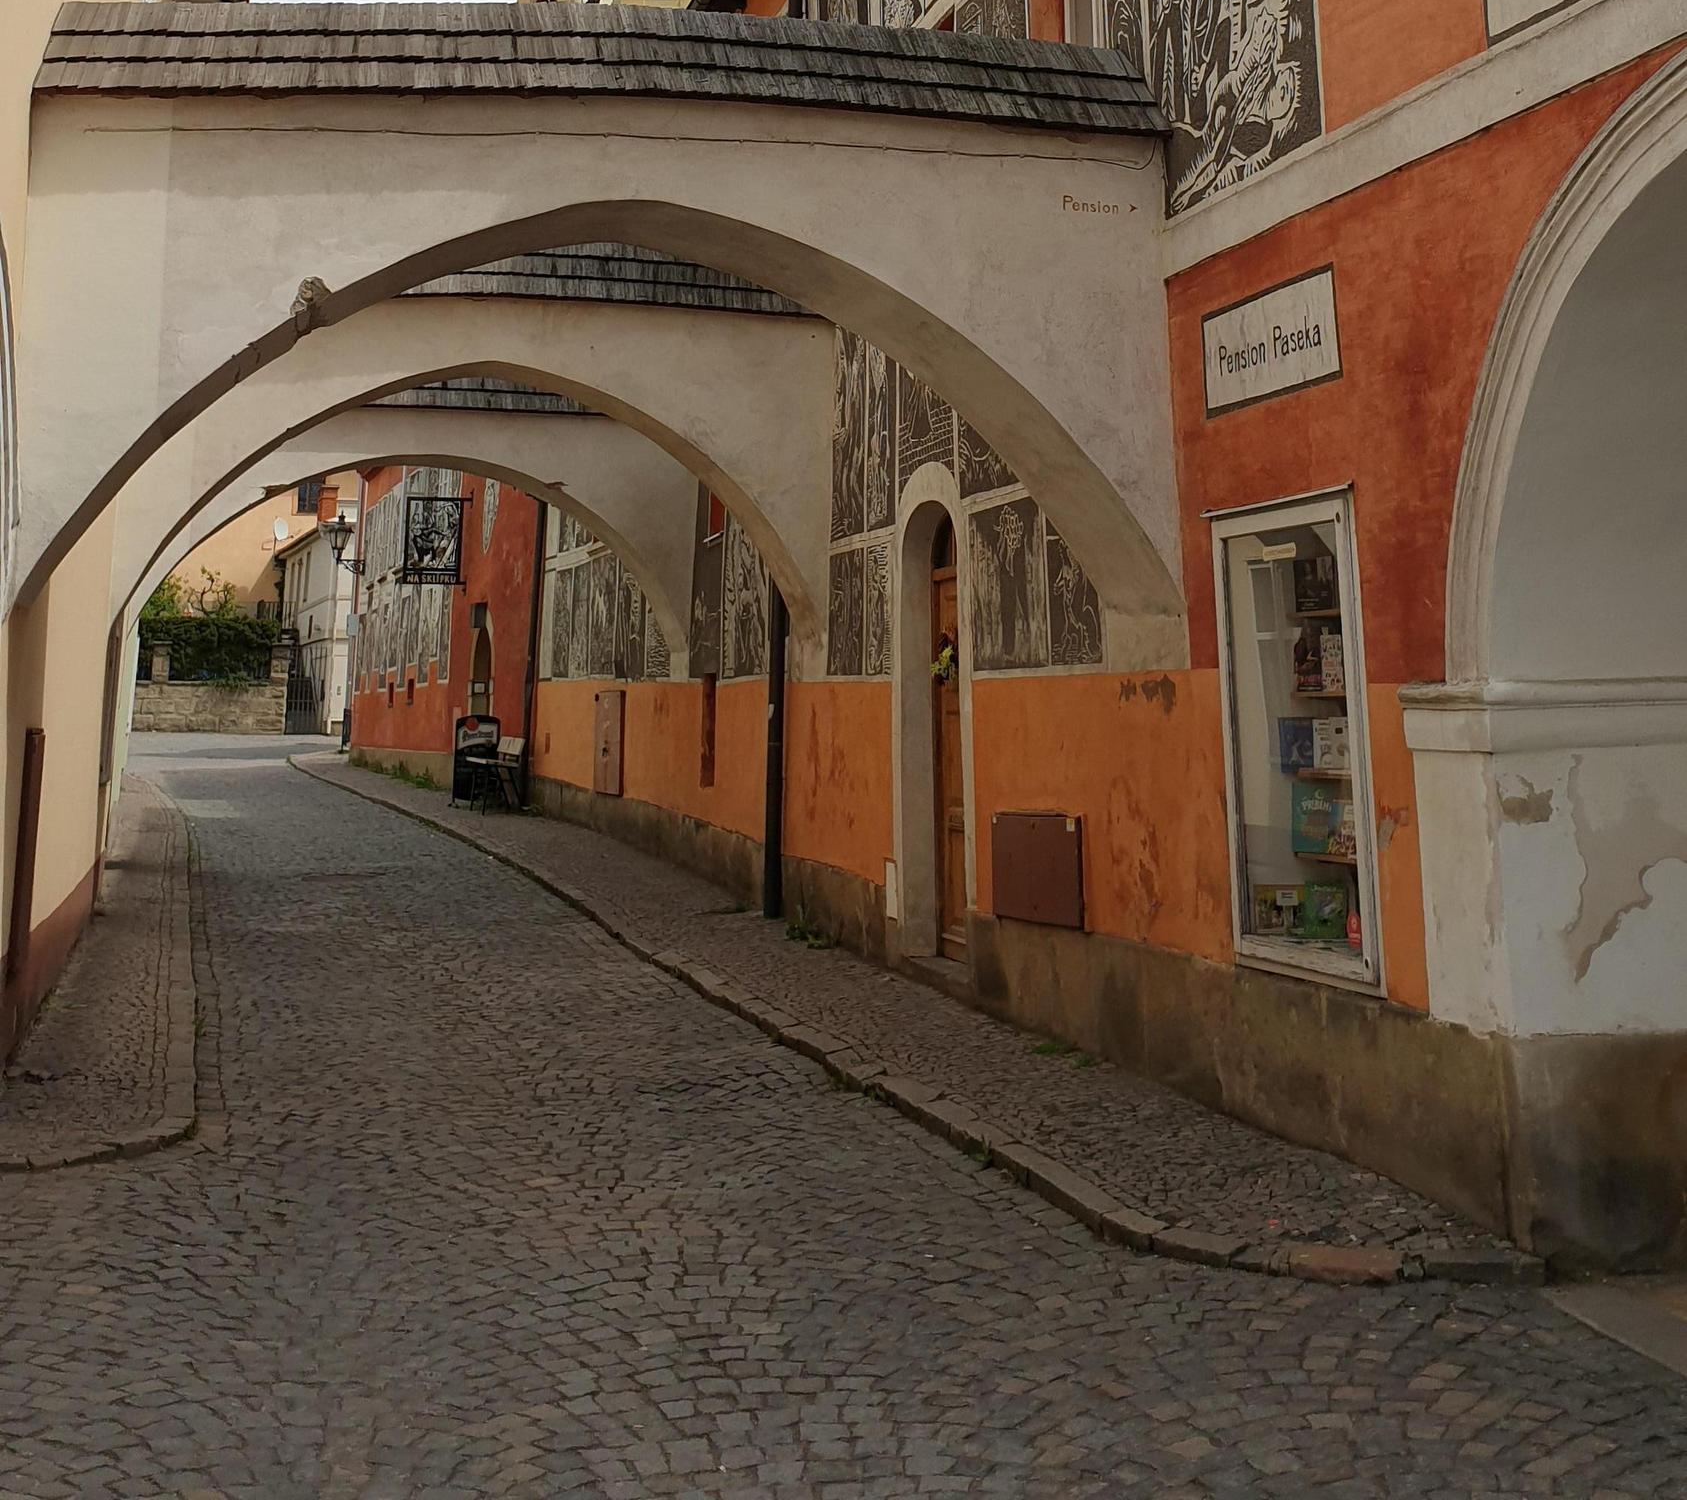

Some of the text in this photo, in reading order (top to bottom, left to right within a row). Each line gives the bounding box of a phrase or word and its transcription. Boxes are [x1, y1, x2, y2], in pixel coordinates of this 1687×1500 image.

[1062, 195, 1119, 215] Pension
[1218, 315, 1322, 377] Pension Paseka
[406, 574, 419, 584] NA
